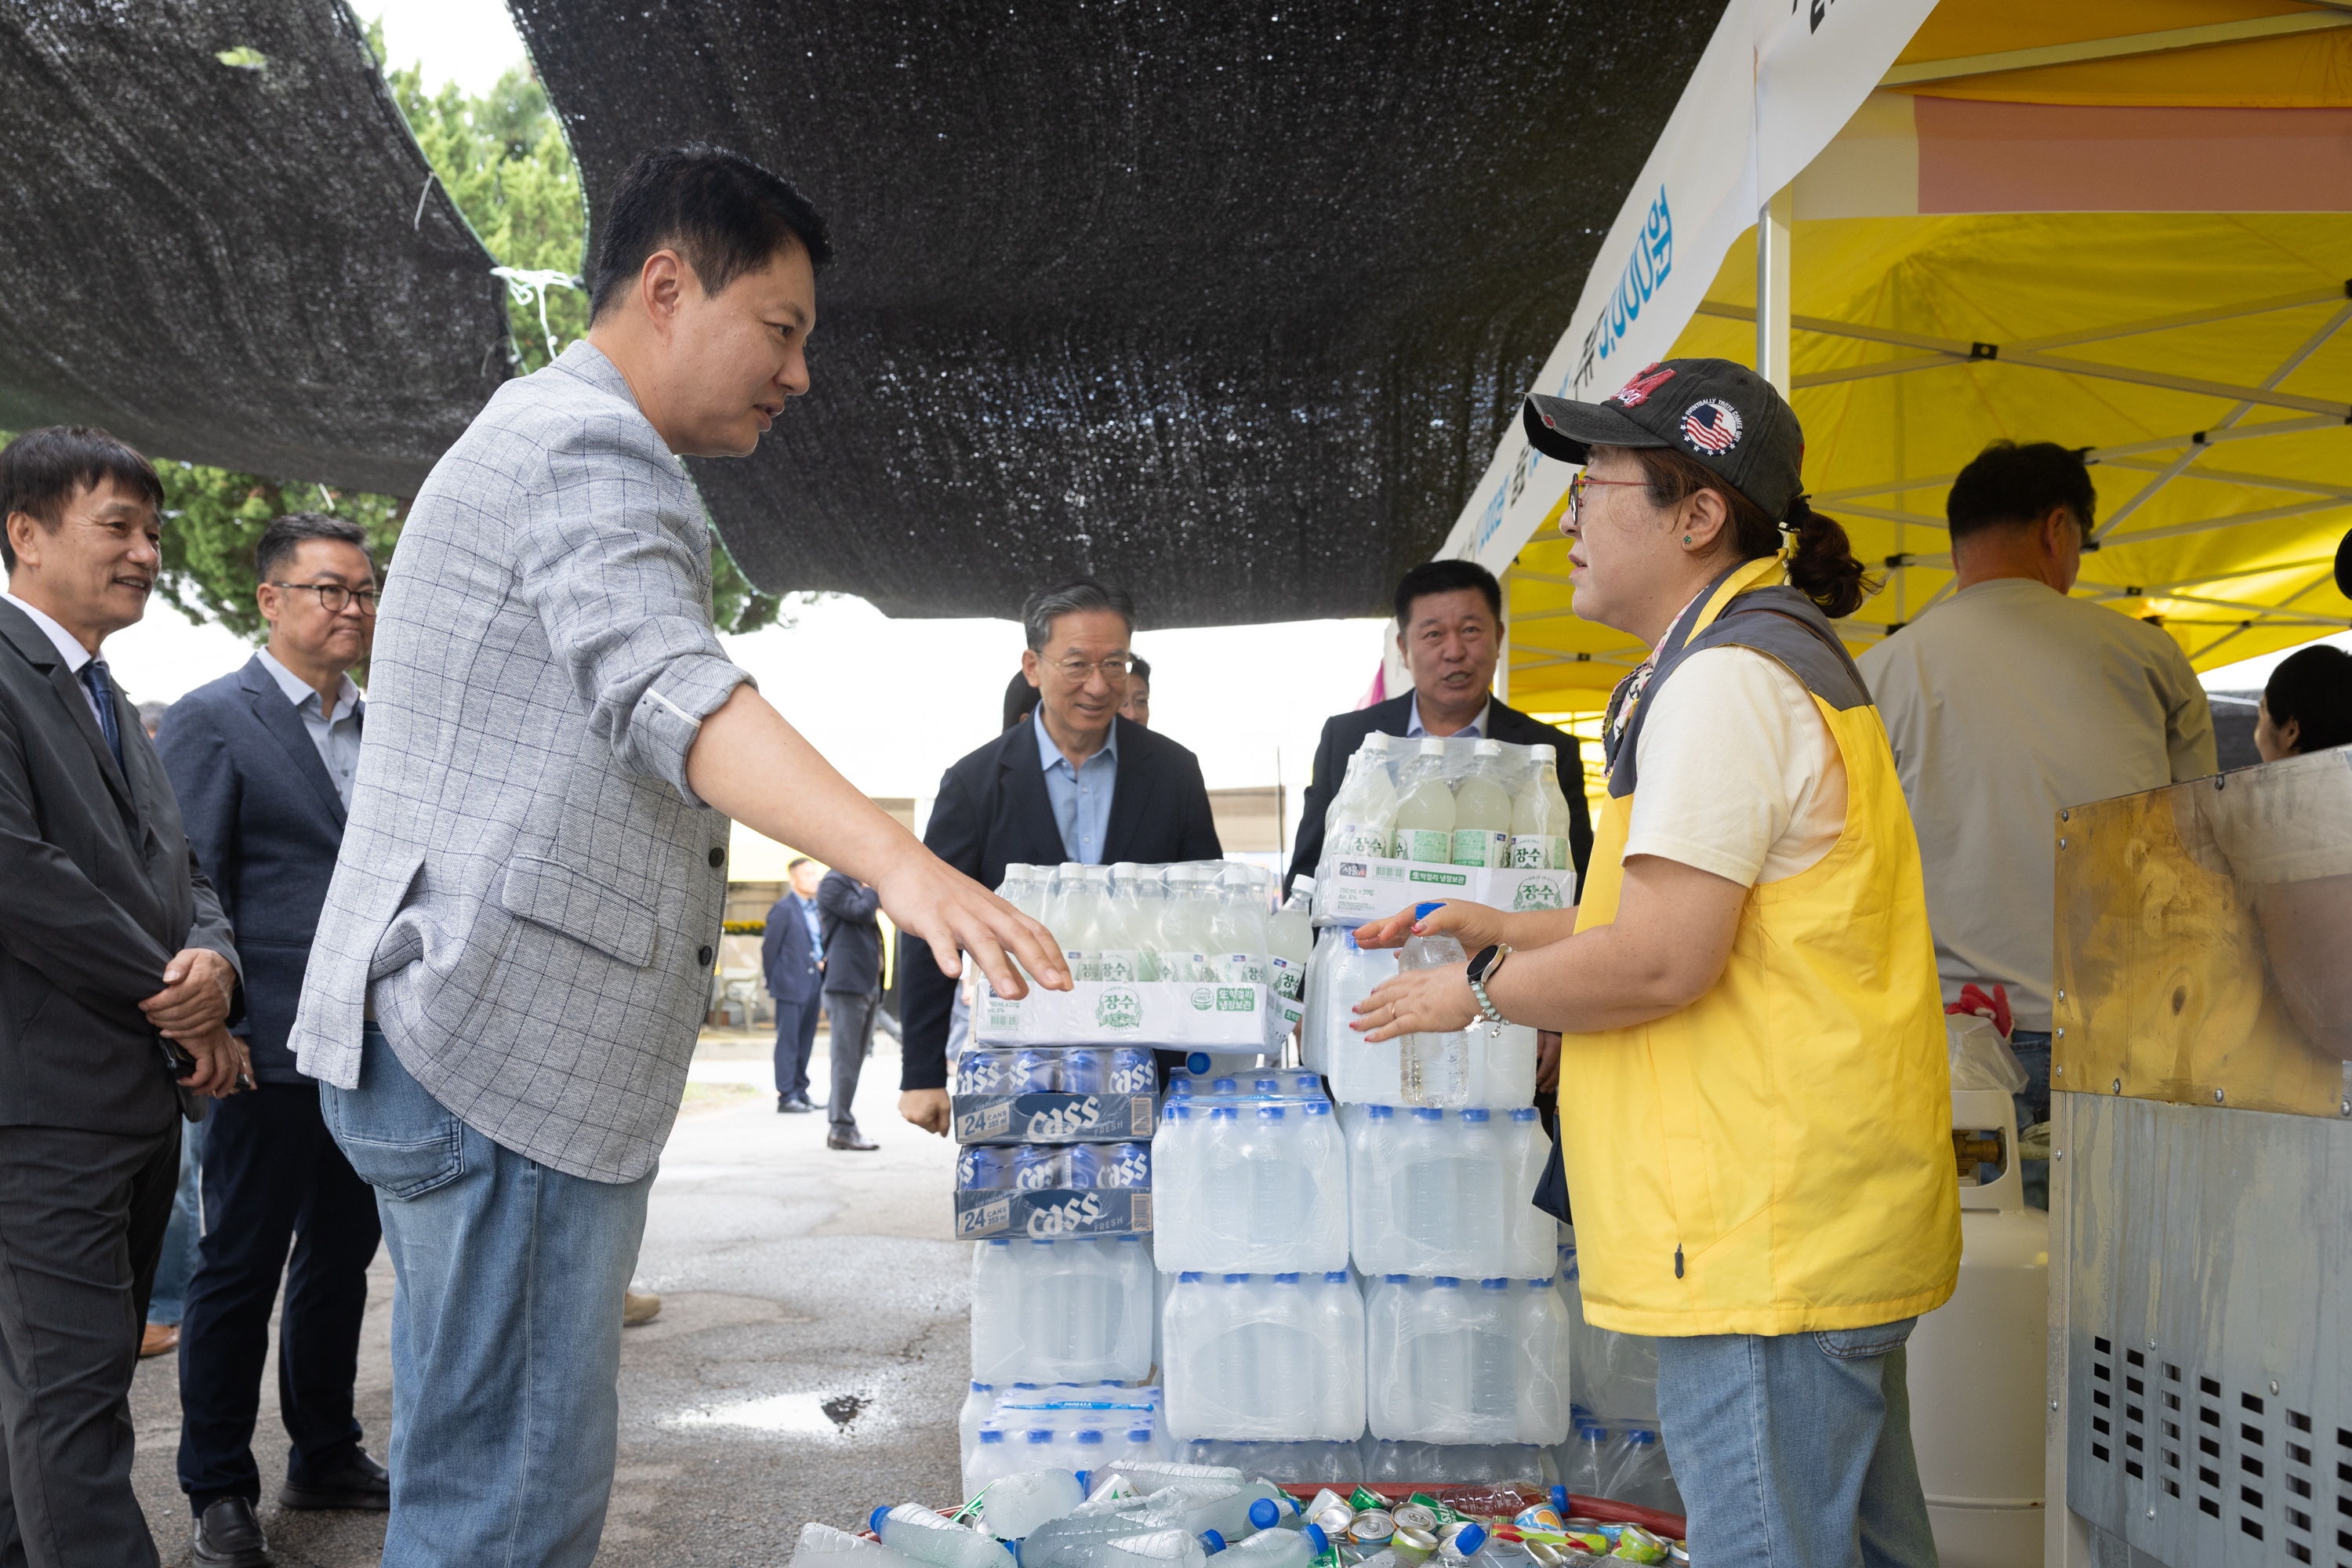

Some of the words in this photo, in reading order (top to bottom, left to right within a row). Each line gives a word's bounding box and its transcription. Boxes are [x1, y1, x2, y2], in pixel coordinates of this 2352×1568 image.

[1685, 397, 1716, 416] EVENTUALLY
[1718, 399, 1735, 412] TRUTH
[1732, 410, 1743, 430] COMES
[1733, 430, 1742, 443] OUT
[1354, 837, 1382, 852] 장수
[1515, 848, 1543, 863] 장수
[1341, 865, 1360, 876] 서울
[1411, 871, 1439, 881] 生막걸리
[1439, 874, 1465, 884] 냉장보관
[1523, 884, 1555, 900] 장수
[1102, 963, 1127, 978] 장수
[1104, 994, 1134, 1010] 장수
[1219, 989, 1252, 1000] 生막걸리
[1219, 1000, 1251, 1010] 냉장보관
[964, 1111, 986, 1135] 24
[987, 1110, 1007, 1120] CANS
[988, 1119, 1000, 1129] 355
[1094, 1120, 1123, 1136] FRESH
[964, 1208, 986, 1232] 24
[987, 1207, 1007, 1218] CANS
[988, 1216, 1000, 1225] 355
[1094, 1216, 1123, 1232] FRESH
